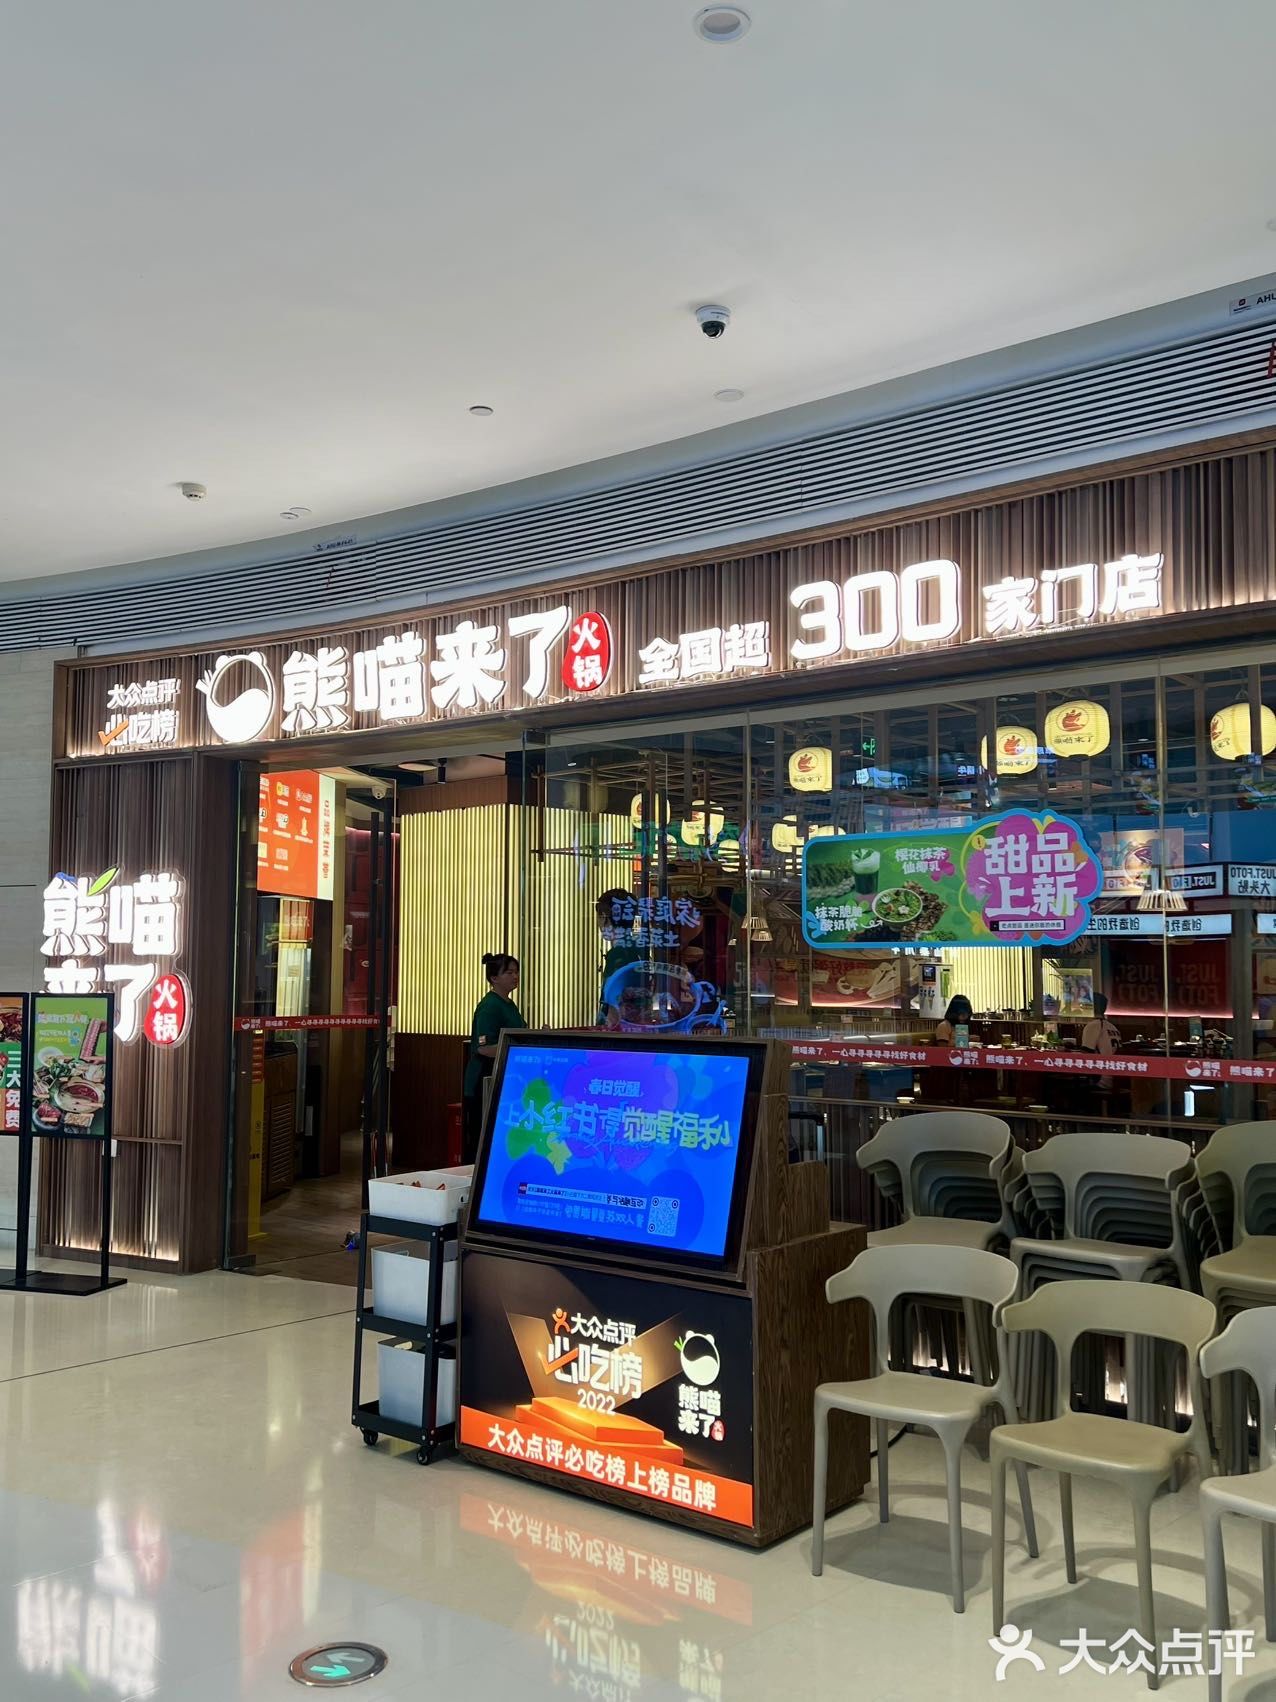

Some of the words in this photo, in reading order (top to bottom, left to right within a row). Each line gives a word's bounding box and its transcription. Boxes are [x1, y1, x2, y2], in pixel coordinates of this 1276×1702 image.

[638, 621, 770, 684] 全国超
[790, 559, 961, 660] 300
[982, 553, 1164, 633] 家门店
[281, 605, 571, 732] 熊喵来了
[572, 616, 602, 689] 火锅
[107, 678, 181, 709] 大众点评
[98, 710, 179, 747] 必吃榜
[984, 832, 1075, 875] 甜品
[40, 872, 181, 956] 熊喵
[984, 873, 1078, 918] 上新
[153, 980, 178, 1041] 火锅
[570, 1312, 637, 1346] 大众点评
[538, 1335, 642, 1399] 必吃榜
[577, 1389, 616, 1416] 2022
[678, 1384, 721, 1417] 熊喵
[678, 1410, 715, 1438] 来了
[488, 1423, 717, 1512] 大众点评必吃榜上榜品牌
